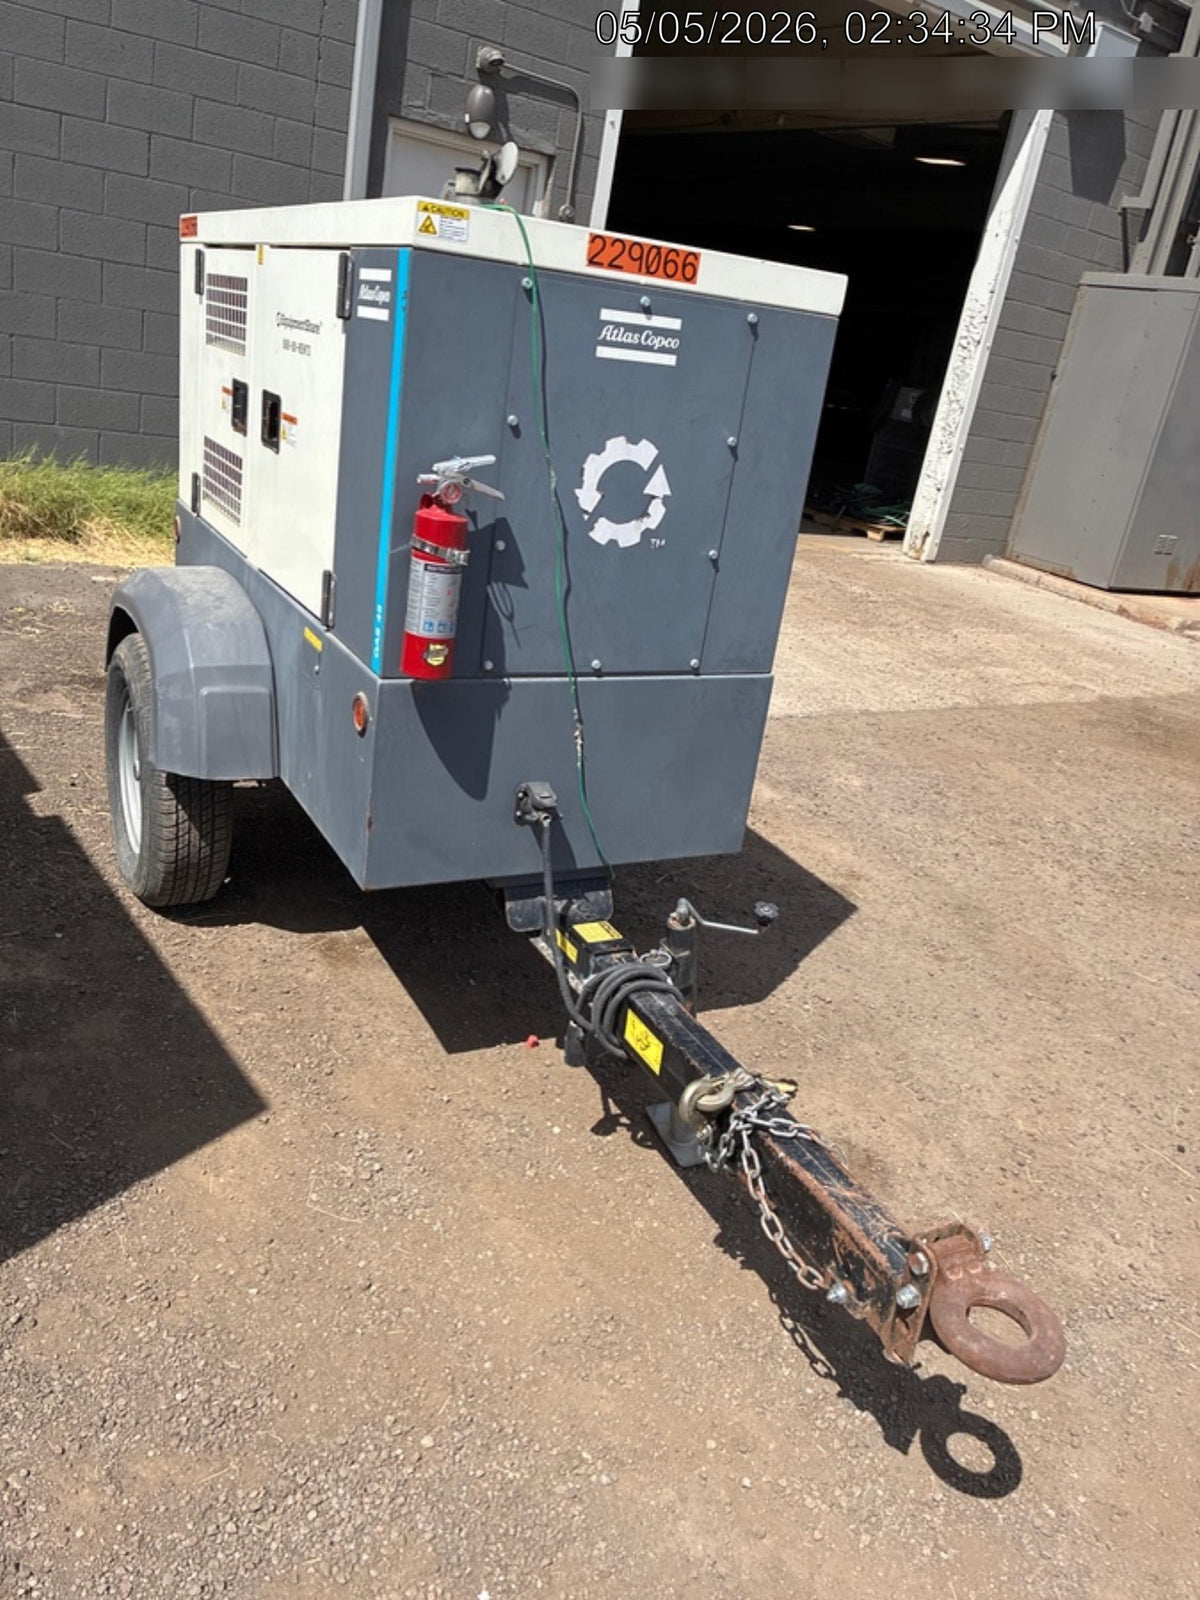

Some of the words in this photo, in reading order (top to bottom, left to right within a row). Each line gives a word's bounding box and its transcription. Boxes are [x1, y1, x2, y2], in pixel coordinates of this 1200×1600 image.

[588, 234, 699, 282] 229066
[598, 324, 640, 345] Atlas
[641, 330, 680, 350] Copco
